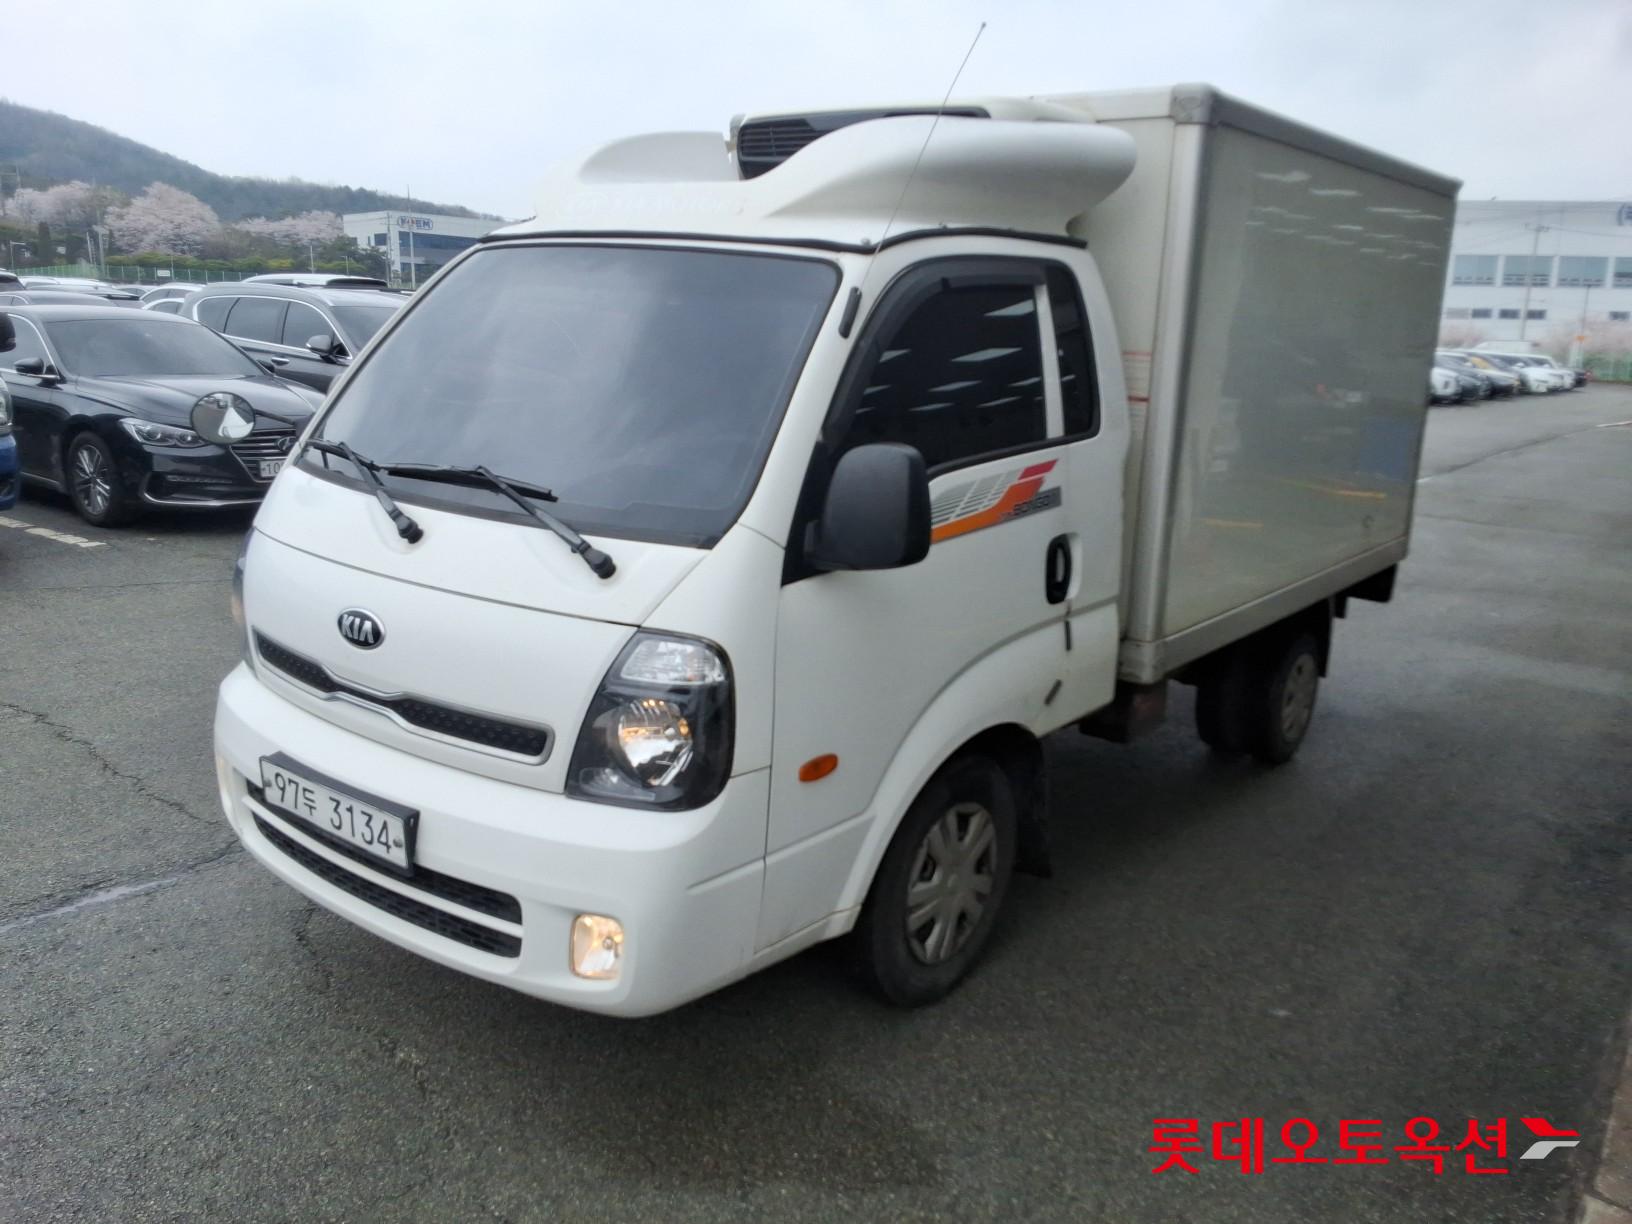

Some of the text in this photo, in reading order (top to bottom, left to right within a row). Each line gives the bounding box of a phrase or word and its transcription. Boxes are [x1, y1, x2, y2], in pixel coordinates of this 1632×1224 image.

[342, 613, 374, 644] KIA
[274, 771, 392, 854] 97두 3134
